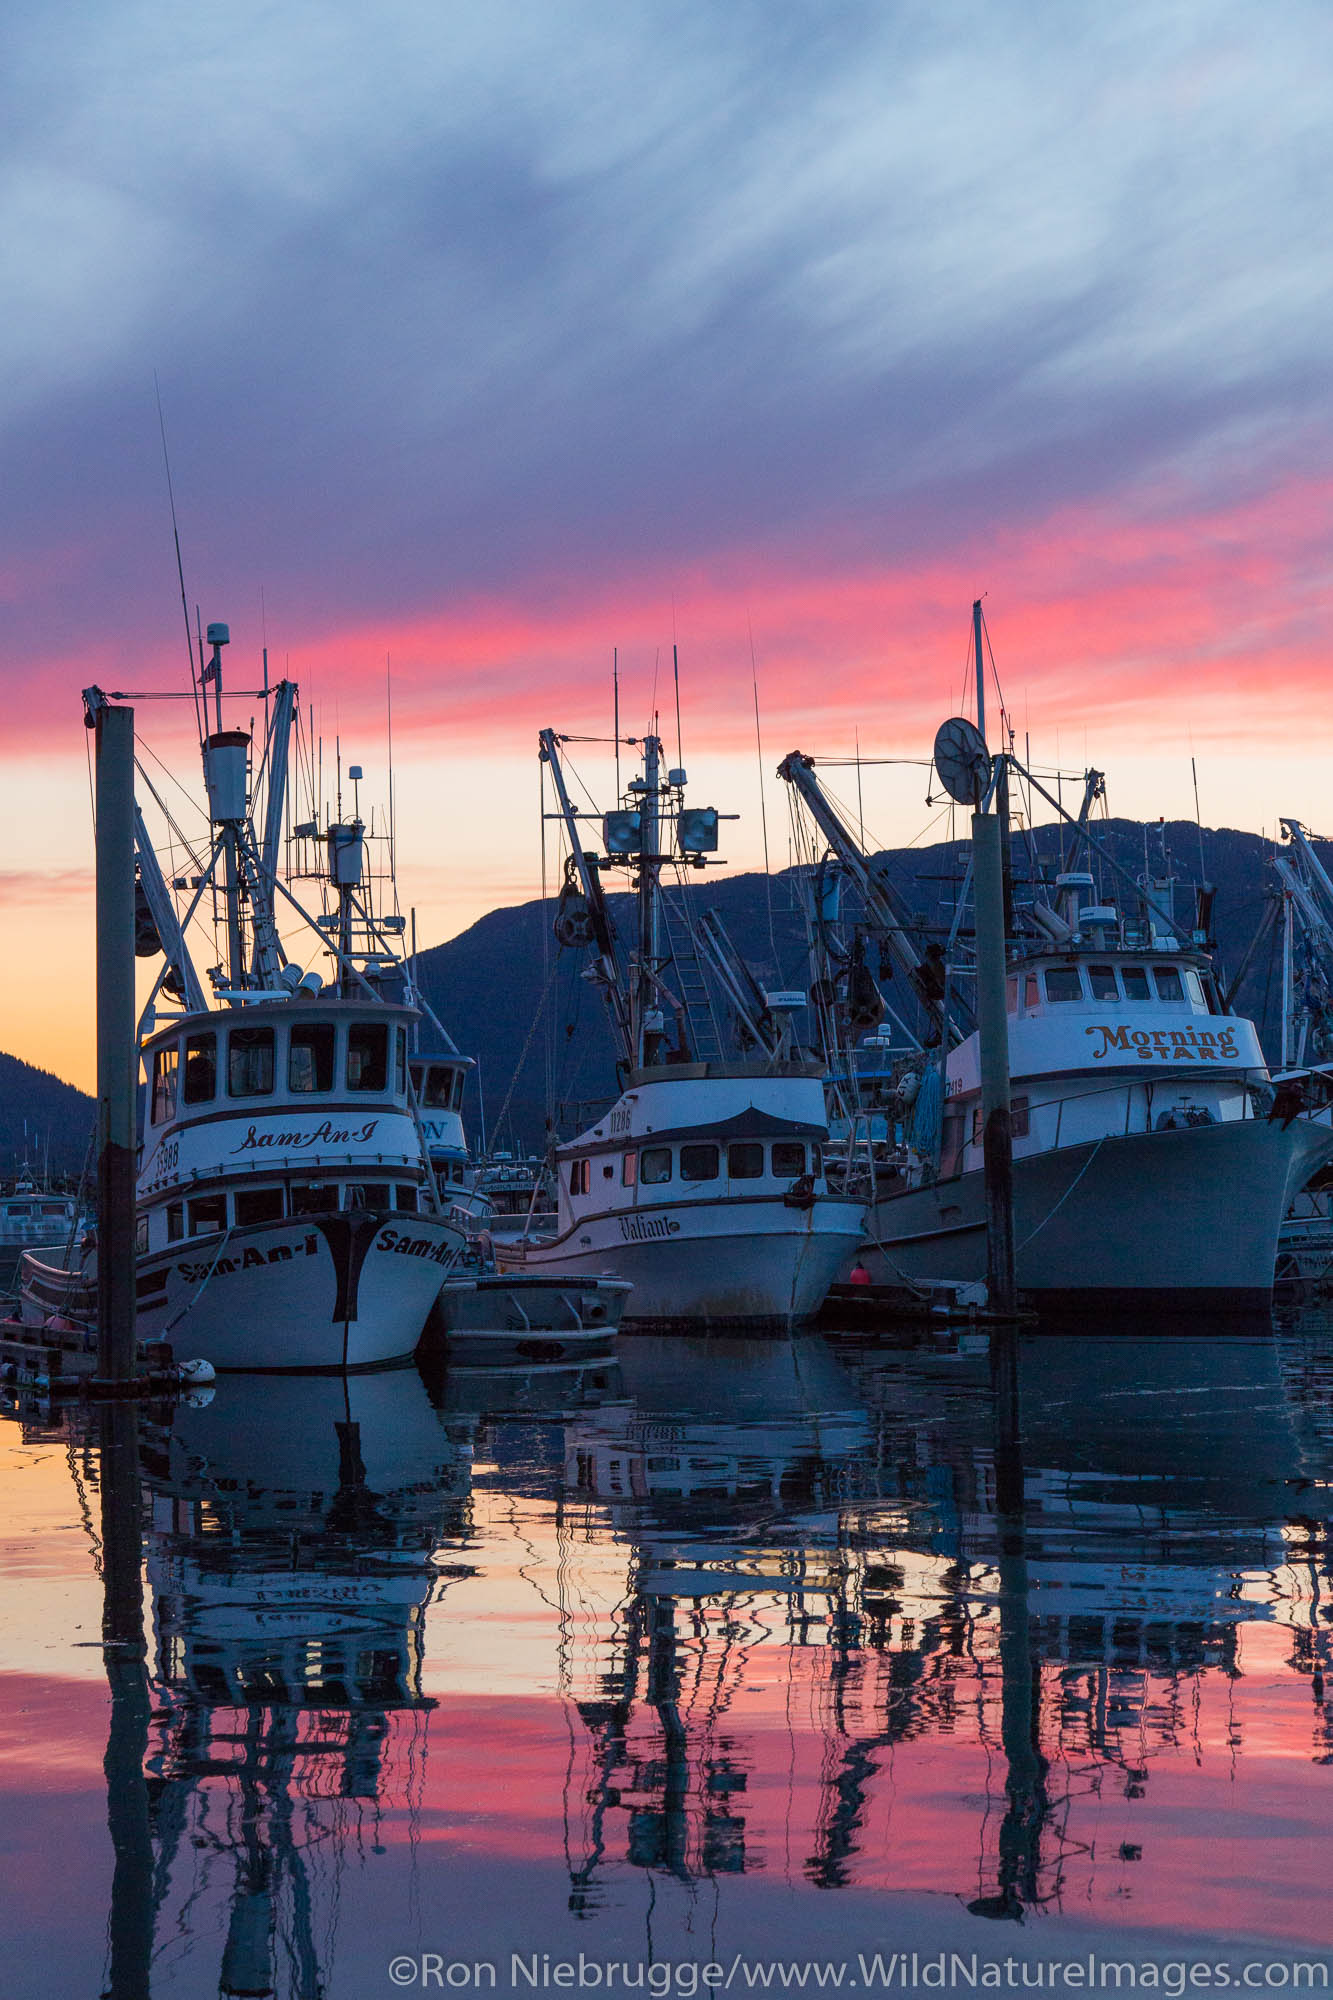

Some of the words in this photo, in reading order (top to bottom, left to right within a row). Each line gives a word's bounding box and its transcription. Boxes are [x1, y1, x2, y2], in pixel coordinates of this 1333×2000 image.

[1085, 1025, 1240, 1059] Morning
[1136, 1046, 1219, 1060] STAR
[229, 1119, 379, 1154] Sam-An-I
[618, 1215, 671, 1241] Valiant
